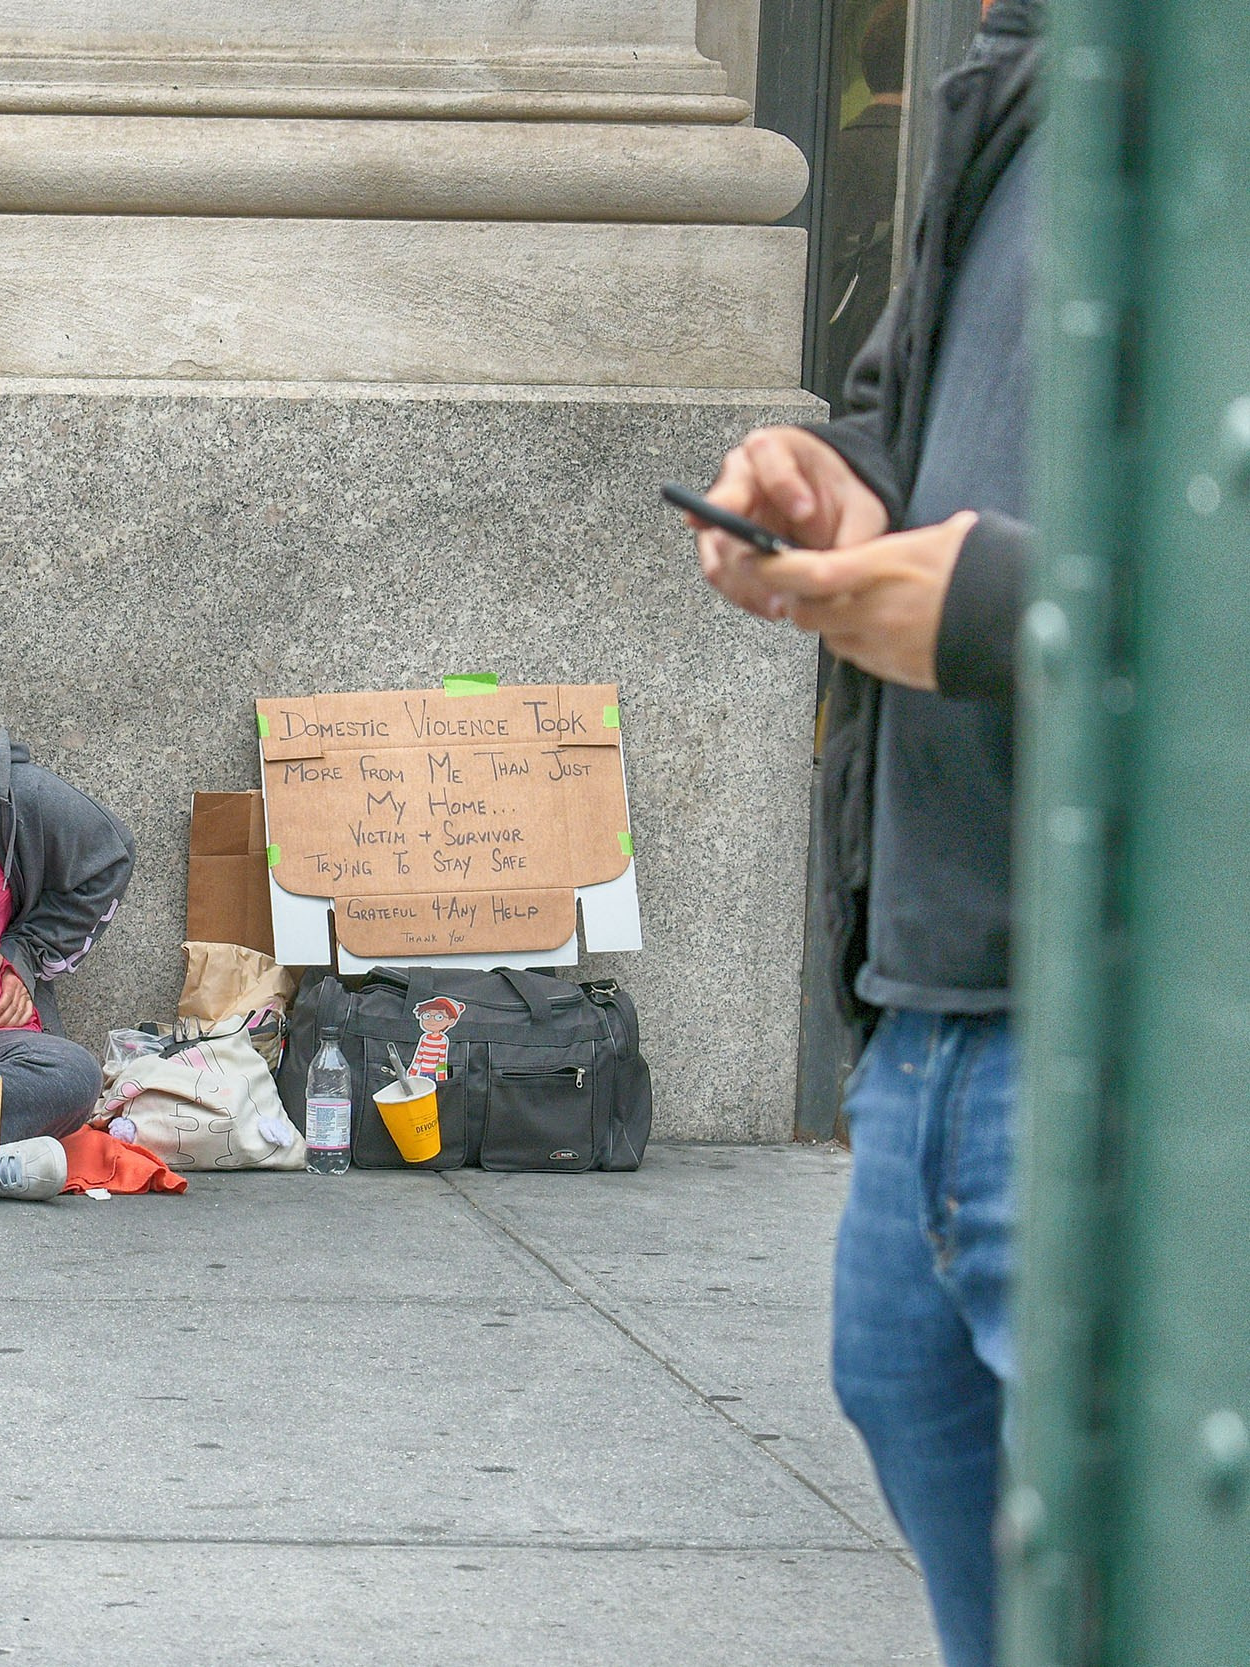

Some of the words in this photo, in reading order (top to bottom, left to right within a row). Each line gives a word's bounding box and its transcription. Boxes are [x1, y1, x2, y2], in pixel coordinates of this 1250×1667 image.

[279, 710, 390, 742] DOMESTIC
[403, 698, 510, 739] VIOLENCE
[522, 701, 587, 736] TOOK
[283, 762, 343, 785] MORE
[359, 754, 405, 783] FROM
[427, 752, 464, 785] ME
[473, 751, 530, 781] THAN
[540, 749, 592, 781] JUST
[366, 790, 407, 825] MY
[348, 820, 406, 848] VICTIM
[442, 819, 525, 847] SURVIVOR
[303, 852, 373, 882] TRYING
[392, 849, 411, 875] TO
[432, 849, 473, 880] STAY
[490, 847, 528, 873] SAFE
[346, 897, 418, 921] GRATEFUL
[491, 894, 540, 925] HELP
[400, 931, 439, 943] THANK
[448, 929, 466, 947] YOU
